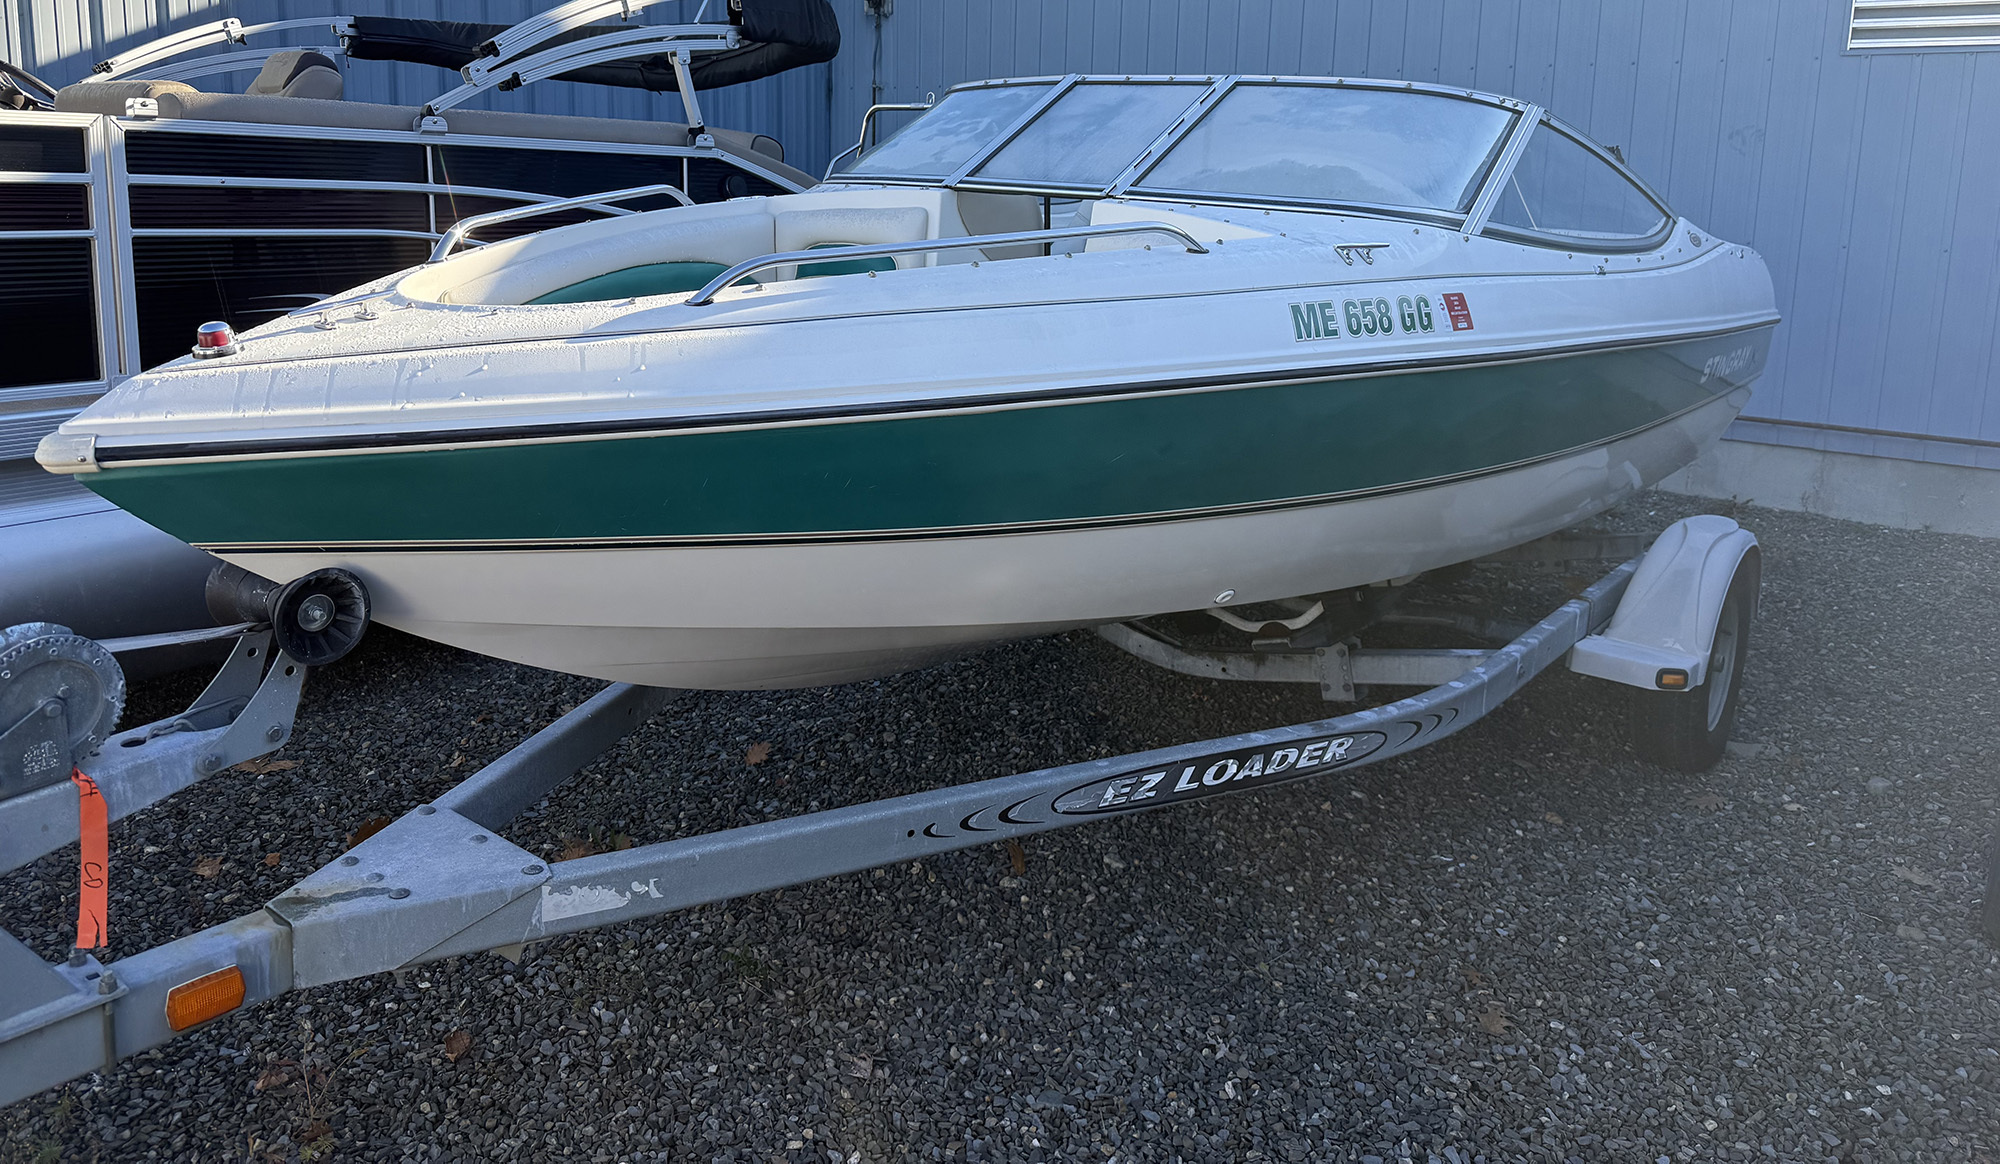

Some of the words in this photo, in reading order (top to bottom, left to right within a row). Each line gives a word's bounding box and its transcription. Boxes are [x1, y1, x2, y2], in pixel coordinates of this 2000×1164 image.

[1288, 299, 1341, 342] ME
[1342, 297, 1395, 338] 658
[1397, 294, 1435, 333] GG
[1700, 345, 1753, 384] STINGRAY
[1098, 770, 1167, 808] EZ
[1173, 736, 1354, 793] LOADER
